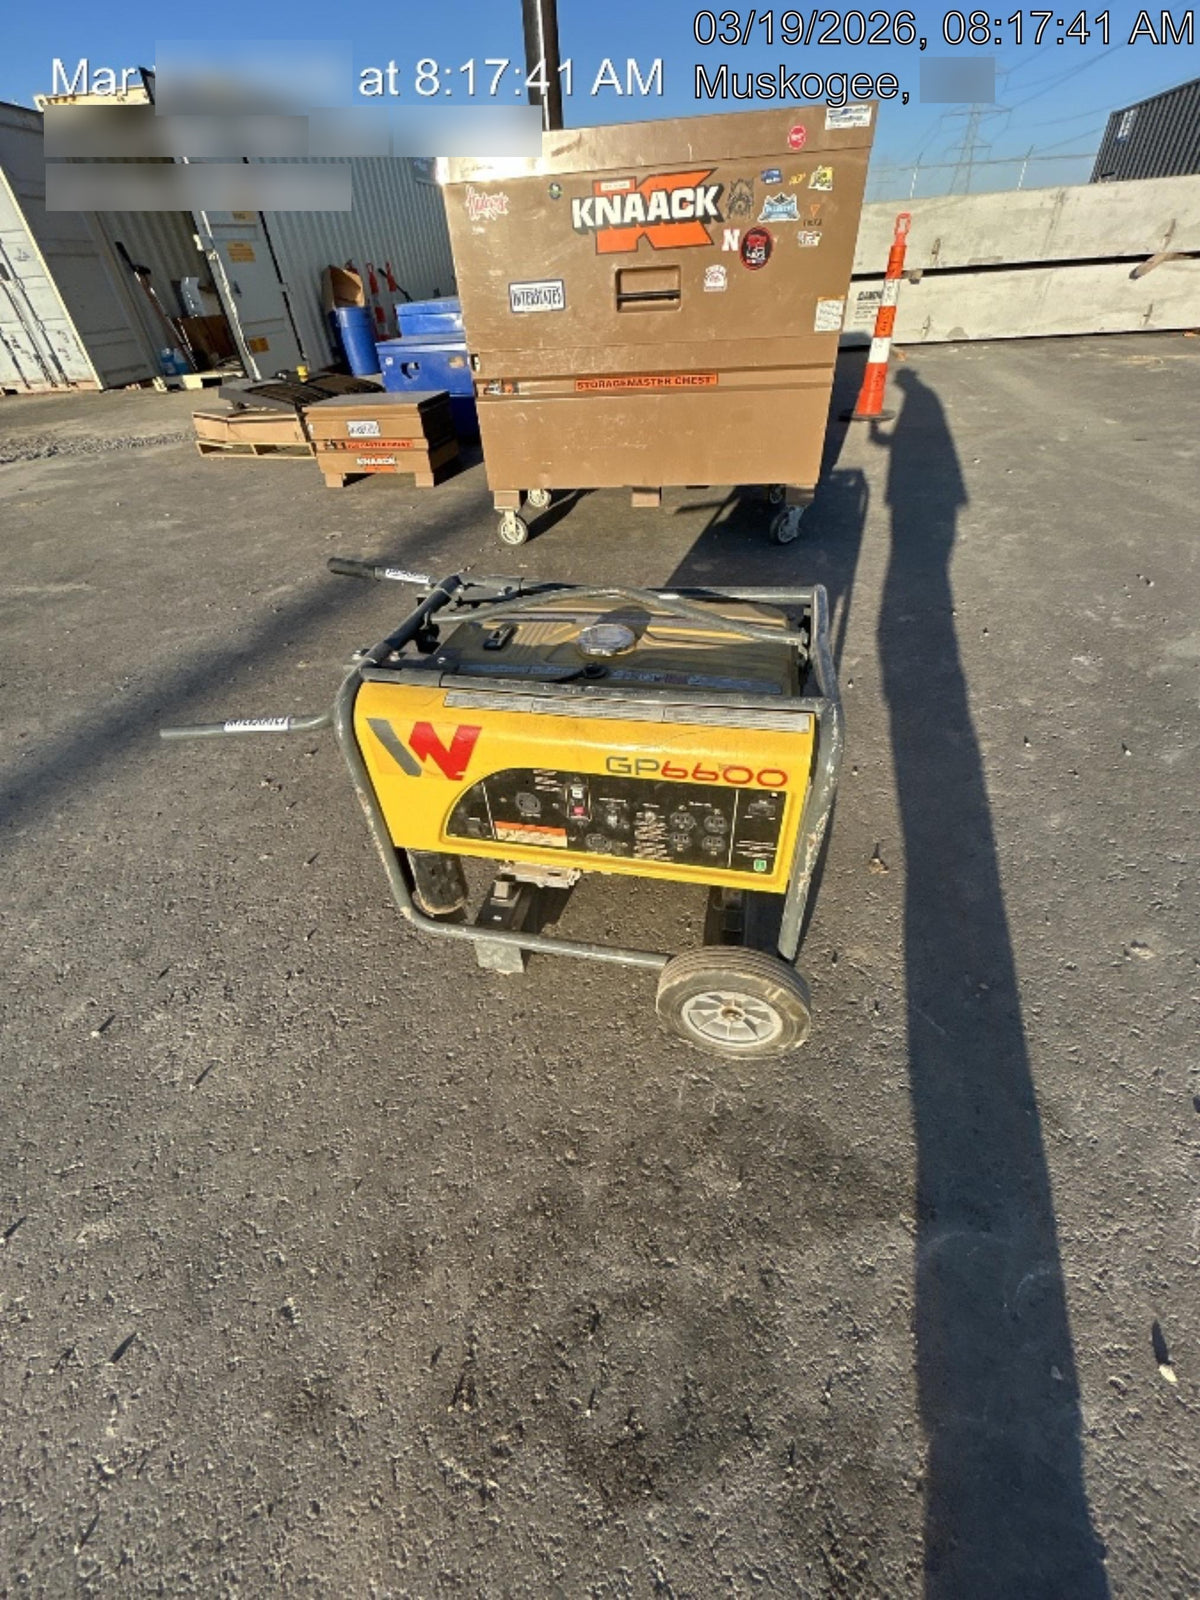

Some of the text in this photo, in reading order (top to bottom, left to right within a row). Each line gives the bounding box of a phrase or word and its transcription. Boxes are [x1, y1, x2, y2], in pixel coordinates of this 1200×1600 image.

[571, 184, 722, 232] KNAACK
[722, 229, 741, 251] N
[675, 375, 712, 385] CHEST
[605, 756, 789, 788] GP6600
